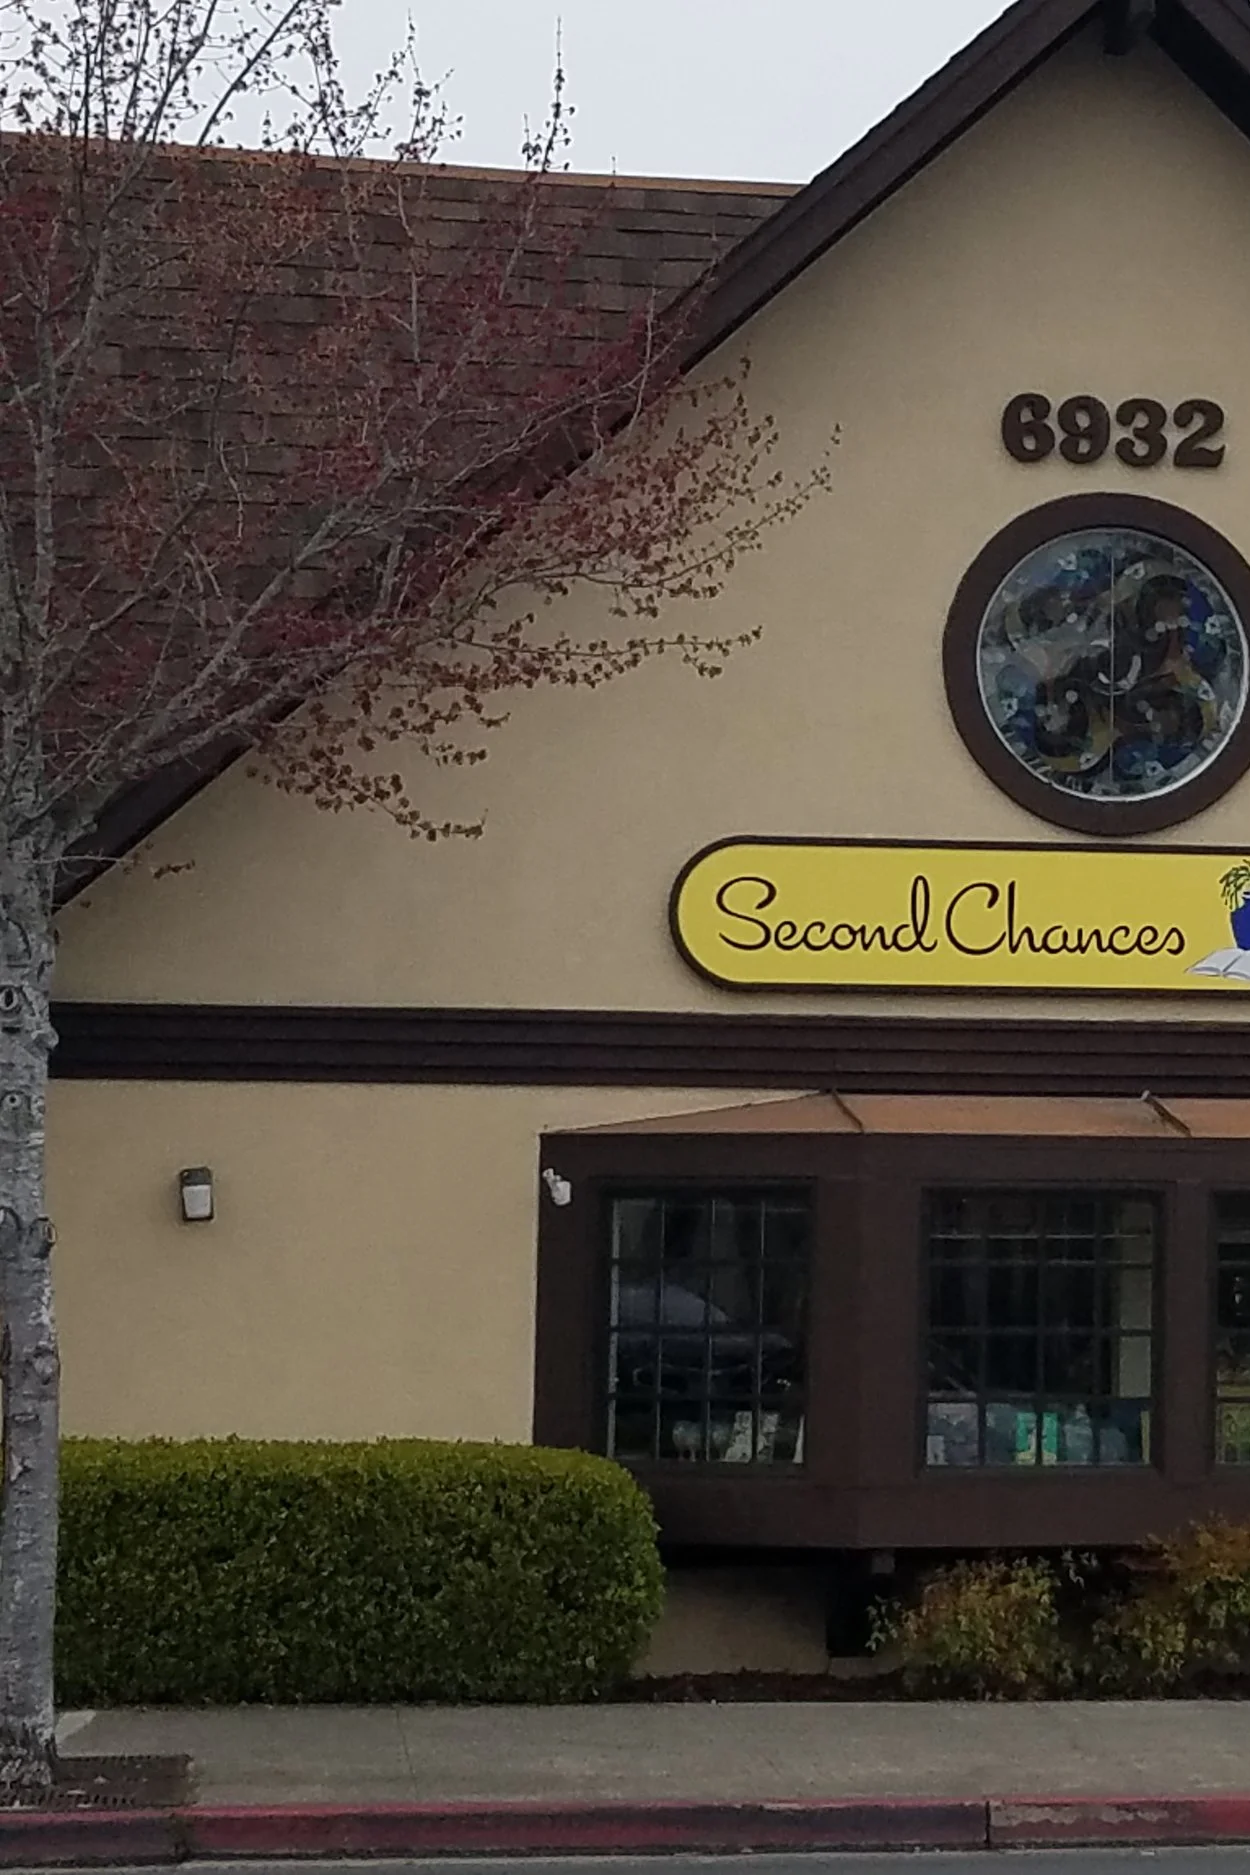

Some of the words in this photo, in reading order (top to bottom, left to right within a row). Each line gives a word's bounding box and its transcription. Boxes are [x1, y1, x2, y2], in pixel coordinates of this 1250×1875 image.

[1001, 392, 1226, 471] 6932
[715, 875, 938, 953] Second
[945, 880, 1186, 956] Chances
